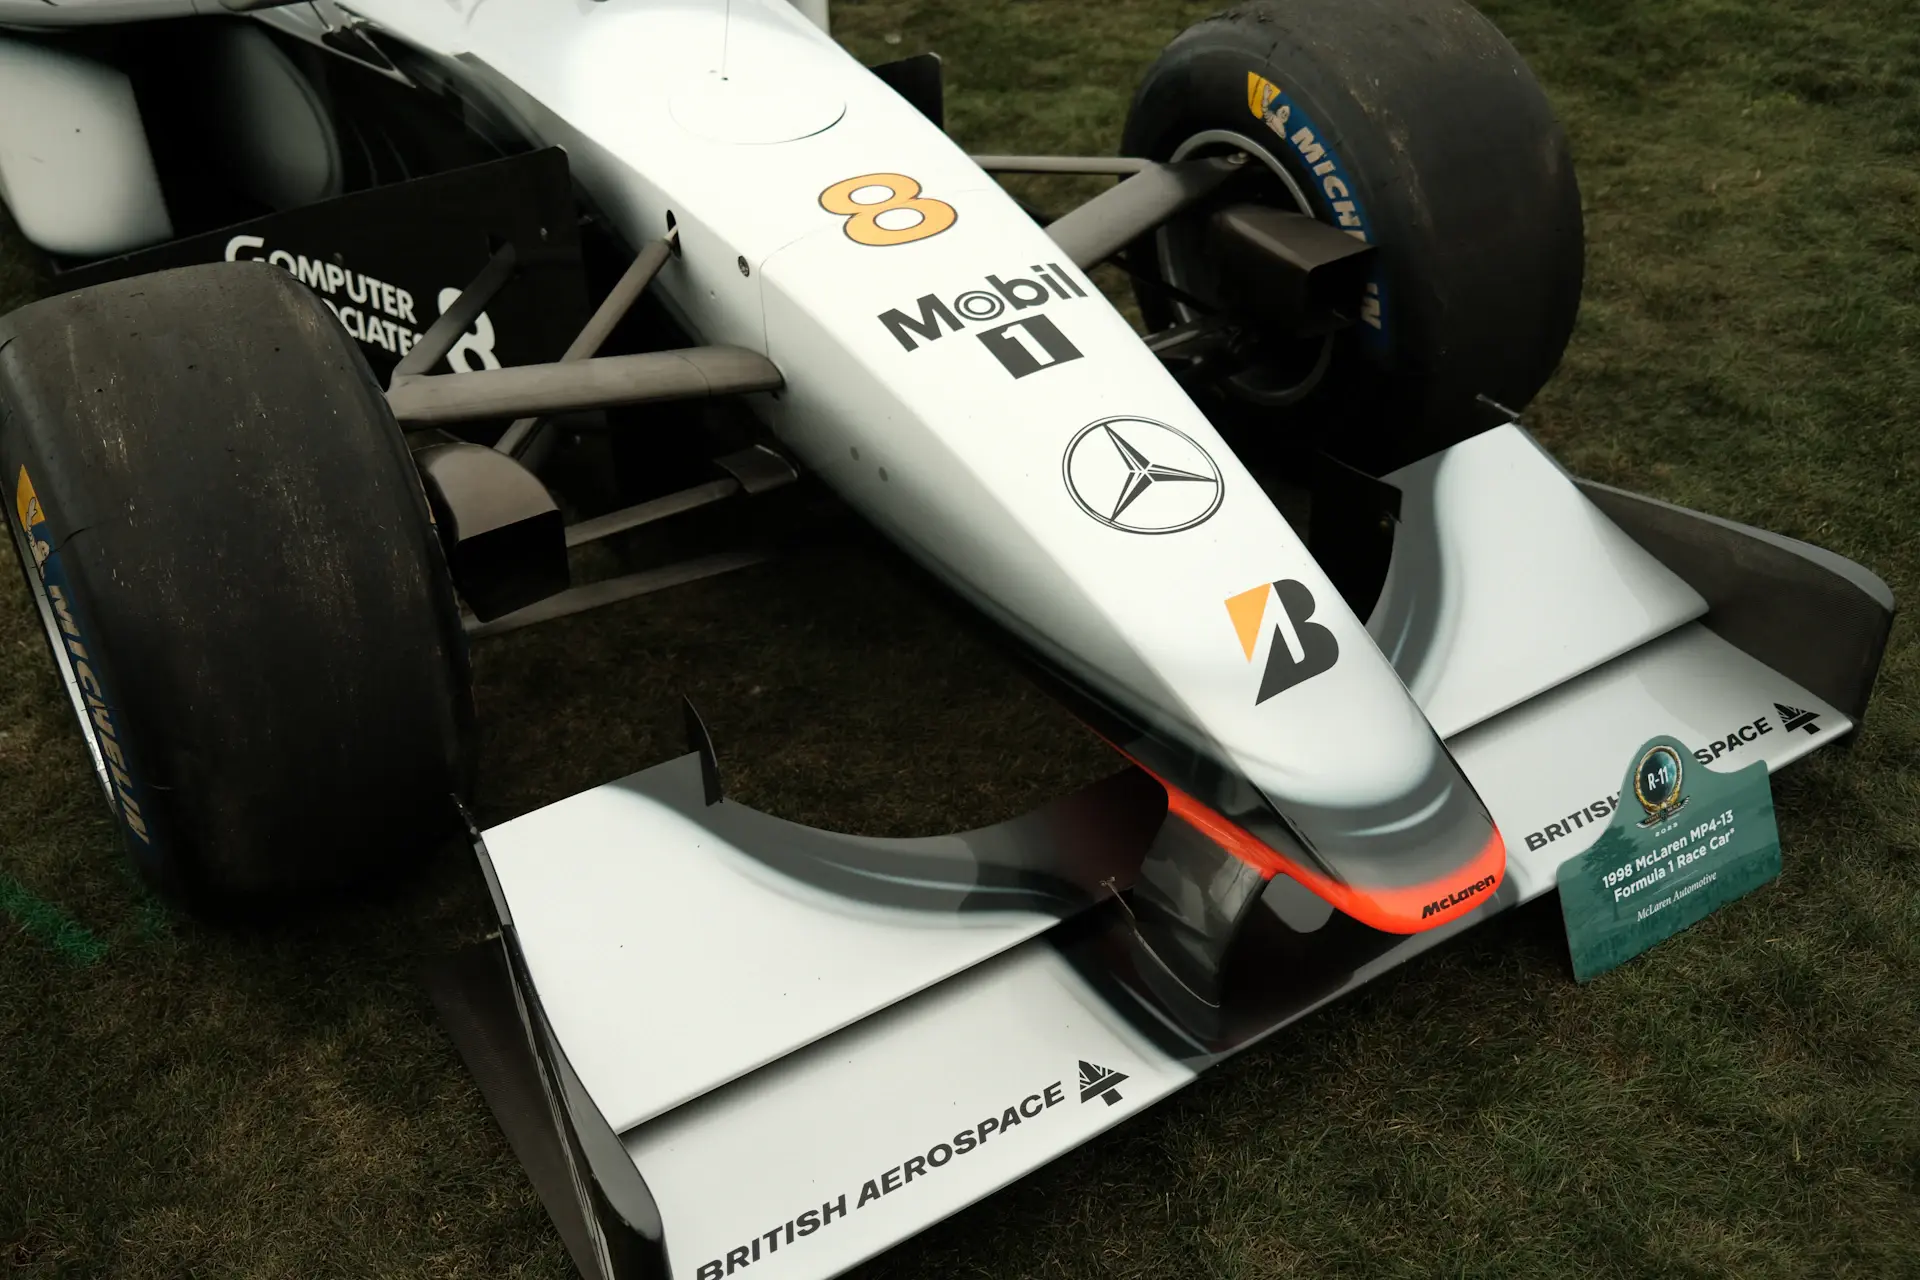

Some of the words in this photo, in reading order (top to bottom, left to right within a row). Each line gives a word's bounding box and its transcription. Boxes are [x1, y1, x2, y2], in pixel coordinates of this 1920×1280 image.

[817, 172, 959, 247] 8
[1290, 126, 1382, 330] MICHIN
[877, 262, 1089, 353] Mobil
[48, 584, 151, 846] MICHELIN
[1647, 765, 1669, 791] R-11
[1602, 863, 1633, 889] 1998
[1635, 835, 1689, 872] McLaren
[1689, 809, 1734, 843] MP4-13
[1613, 867, 1667, 903] Formula
[1667, 859, 1675, 873] 1
[1676, 845, 1707, 869] Race
[1421, 874, 1496, 920] McLaren
[1637, 896, 1673, 922] McLaren
[1673, 871, 1717, 902] Automotive
[696, 1193, 847, 1280] BRITISH
[856, 1079, 1066, 1210] AEROSPACE
